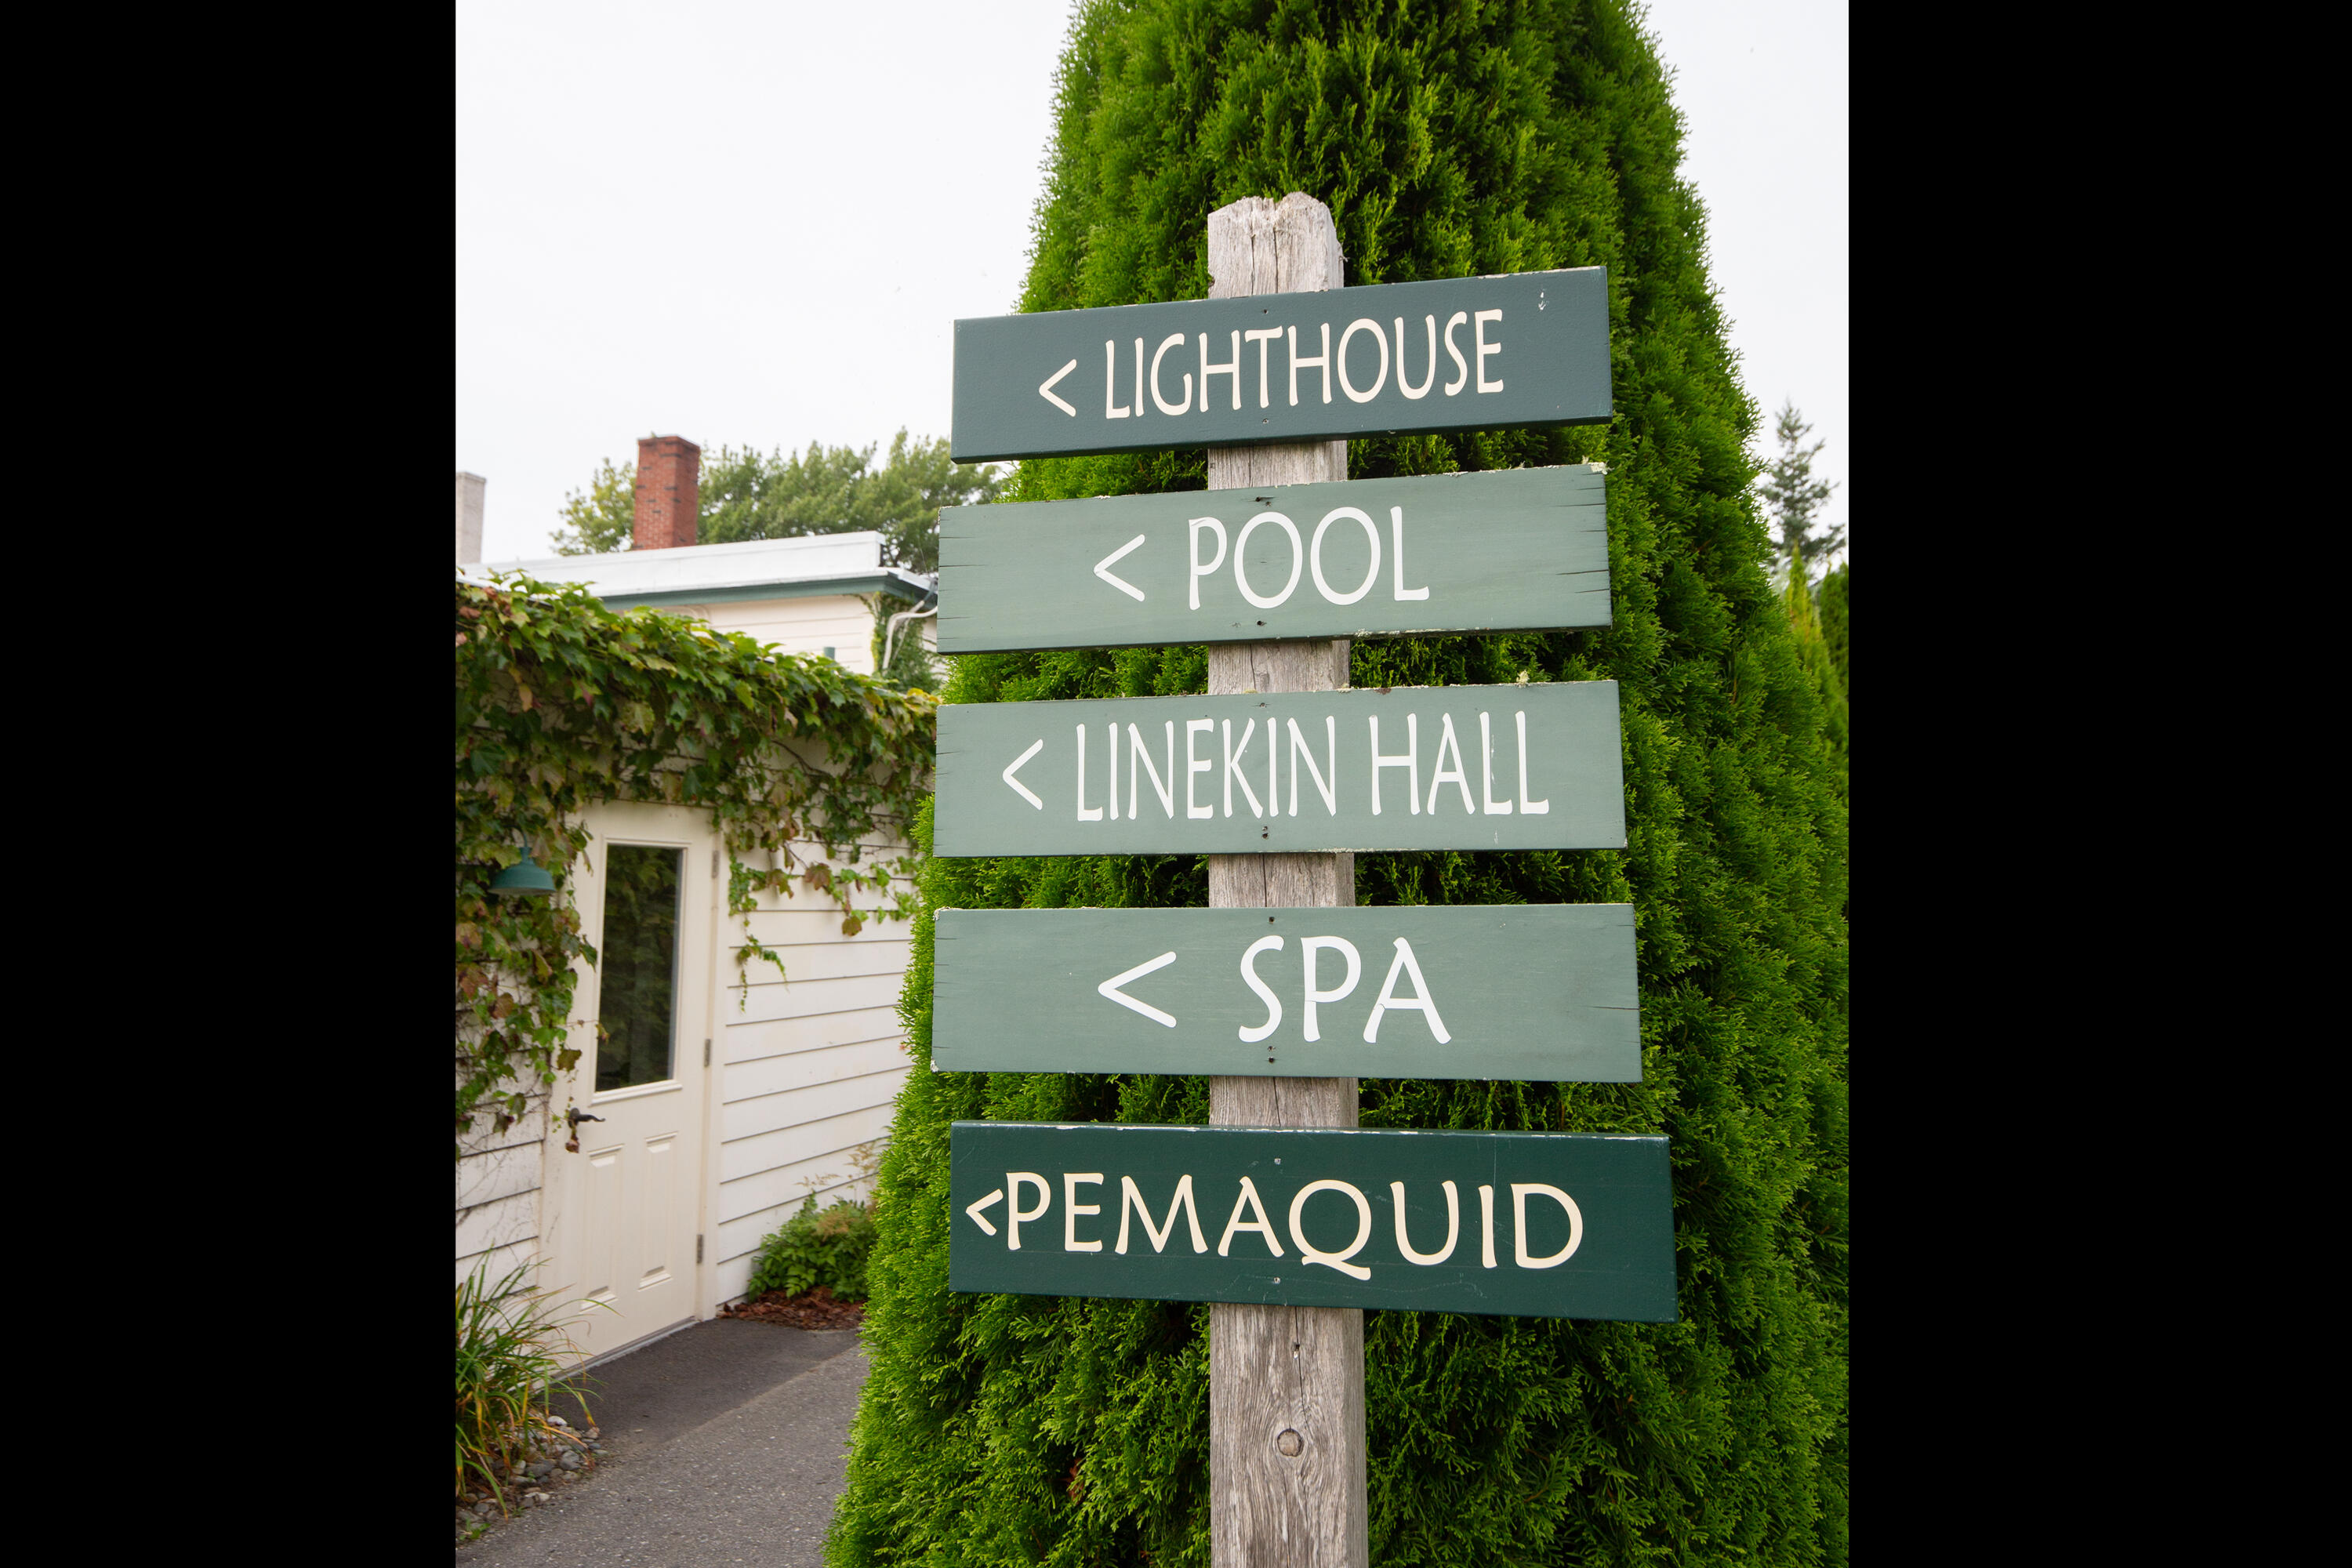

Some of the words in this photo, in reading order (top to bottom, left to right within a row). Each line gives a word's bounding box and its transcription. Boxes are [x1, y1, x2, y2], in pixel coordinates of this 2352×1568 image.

[1105, 308, 1504, 420] LIGHTHOUSE
[1187, 505, 1431, 612] POOL
[1075, 714, 1338, 822] LINEKIN
[1367, 710, 1551, 817] HALL
[1237, 934, 1453, 1045] SPA
[1005, 1171, 1584, 1281] PEMAQUID
